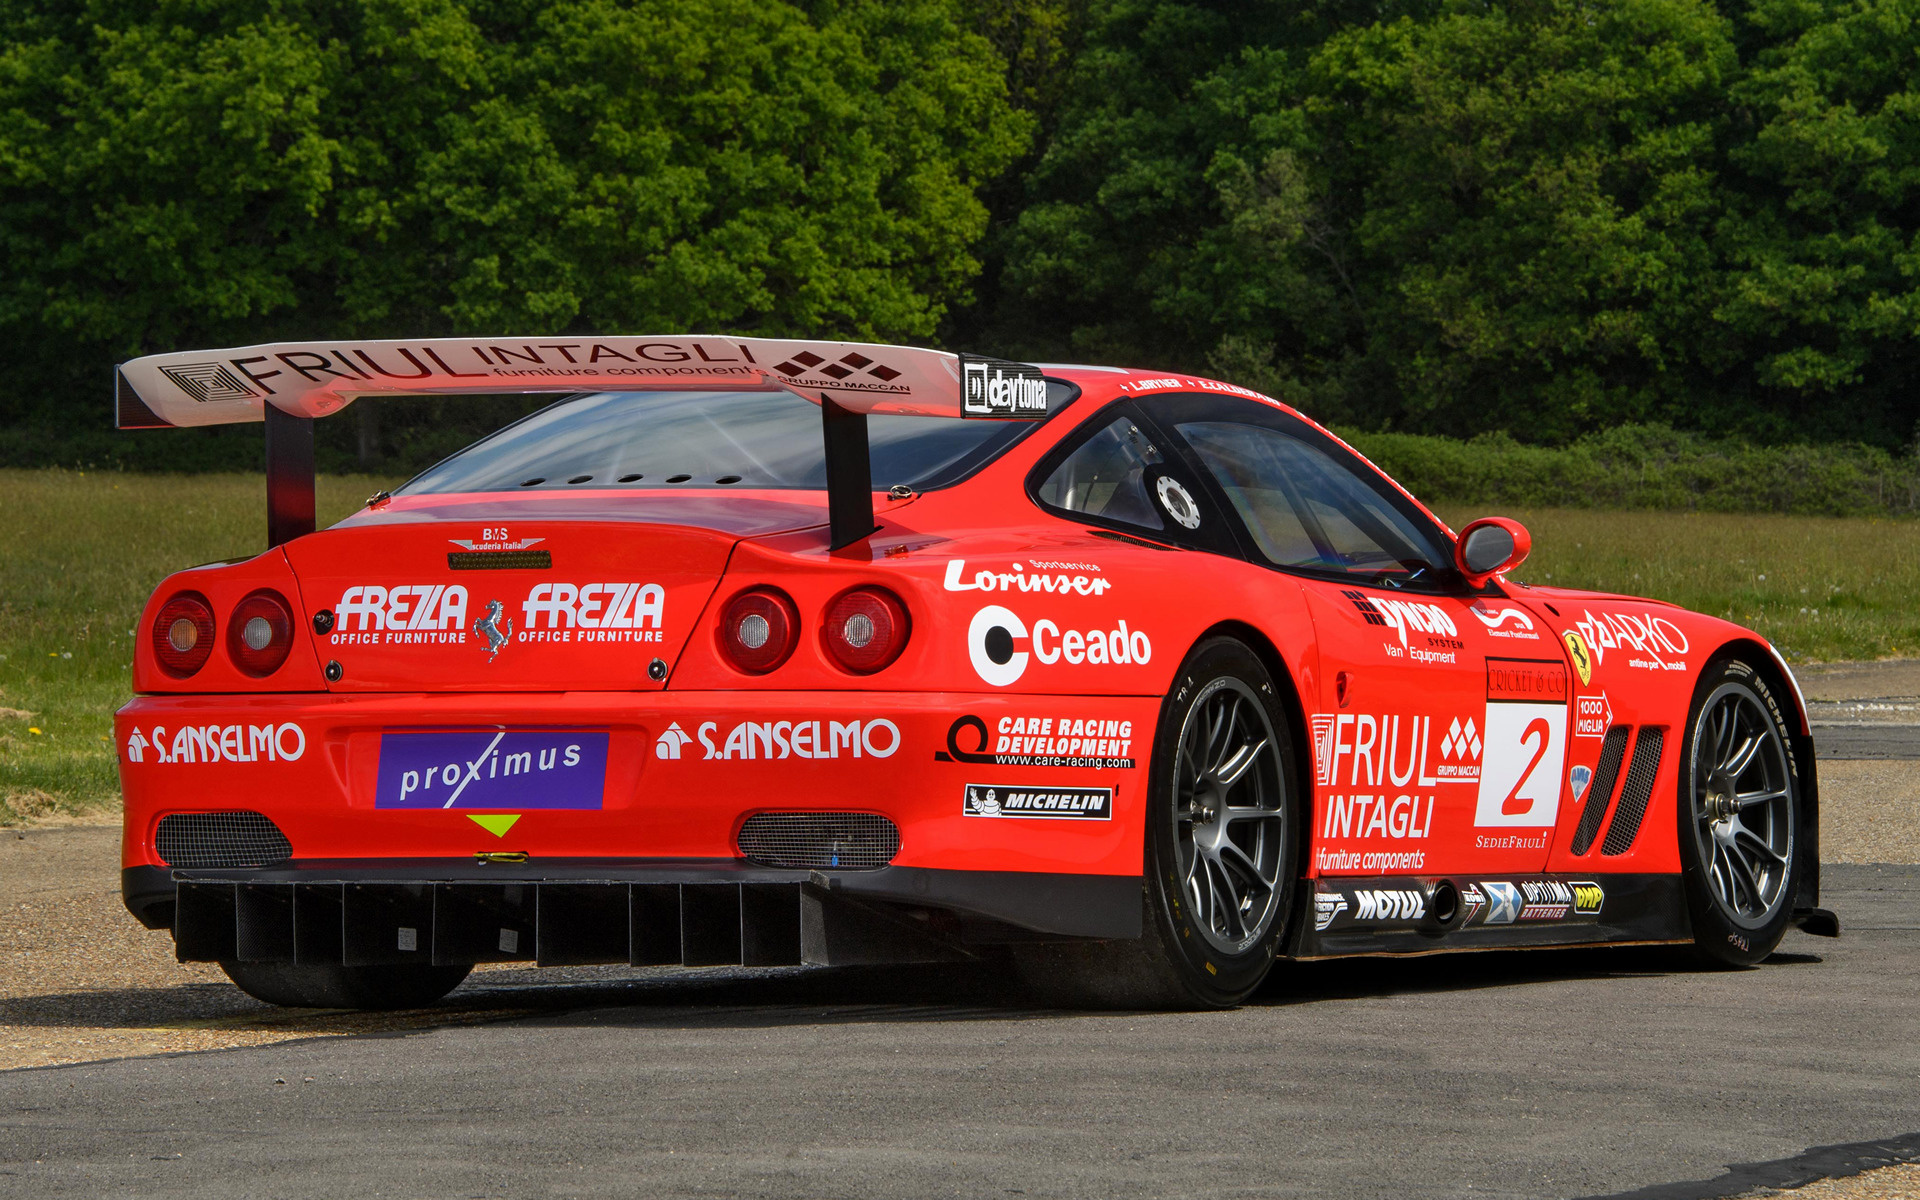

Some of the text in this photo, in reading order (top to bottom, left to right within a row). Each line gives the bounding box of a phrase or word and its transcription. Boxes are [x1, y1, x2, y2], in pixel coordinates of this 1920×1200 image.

[229, 343, 757, 394] FRIUL INTAGLI
[493, 365, 768, 377] furniture components
[776, 376, 911, 392] GRUPPO MACCAN
[988, 370, 1047, 412] daytona
[483, 528, 508, 541] BMS
[472, 541, 521, 550] scuderia italia
[1029, 559, 1101, 572] Sportservice
[943, 559, 1111, 596] Lorinser
[335, 585, 468, 630] FREZZA
[522, 583, 665, 628] FREZZA
[331, 632, 466, 645] OFFICE FURNITURE
[518, 630, 663, 643] OFFICE FURNITURE
[1032, 618, 1152, 665] Ceado
[1428, 637, 1464, 649] SYSTEM
[1383, 643, 1456, 664] Van Equipment
[1667, 661, 1687, 671] mobili
[1488, 669, 1532, 692] CRICKET
[1549, 671, 1565, 693] CO
[1580, 701, 1603, 715] 1000
[997, 716, 1132, 737] CARE RACING
[1578, 718, 1603, 733] MIGLIA
[1754, 675, 1798, 778] MICHELIN
[152, 722, 306, 763] S.ANSELMO
[697, 718, 901, 760] S.ANSELMO
[995, 736, 1131, 756] DEVELOPMENT
[1331, 714, 1437, 787] FRIUL
[400, 734, 581, 808] proximus
[995, 754, 1131, 770] www.care-racing.com
[1437, 765, 1481, 776] GRUPPO MACCAN
[1501, 717, 1550, 816] 2
[1005, 793, 1105, 810] MICHELIN
[1323, 795, 1434, 838] INTAGLI
[1318, 847, 1426, 874] furniture components
[1521, 881, 1572, 902] OPTIMA
[1354, 890, 1426, 920] MOTUL
[1520, 908, 1567, 919] BATTERIES
